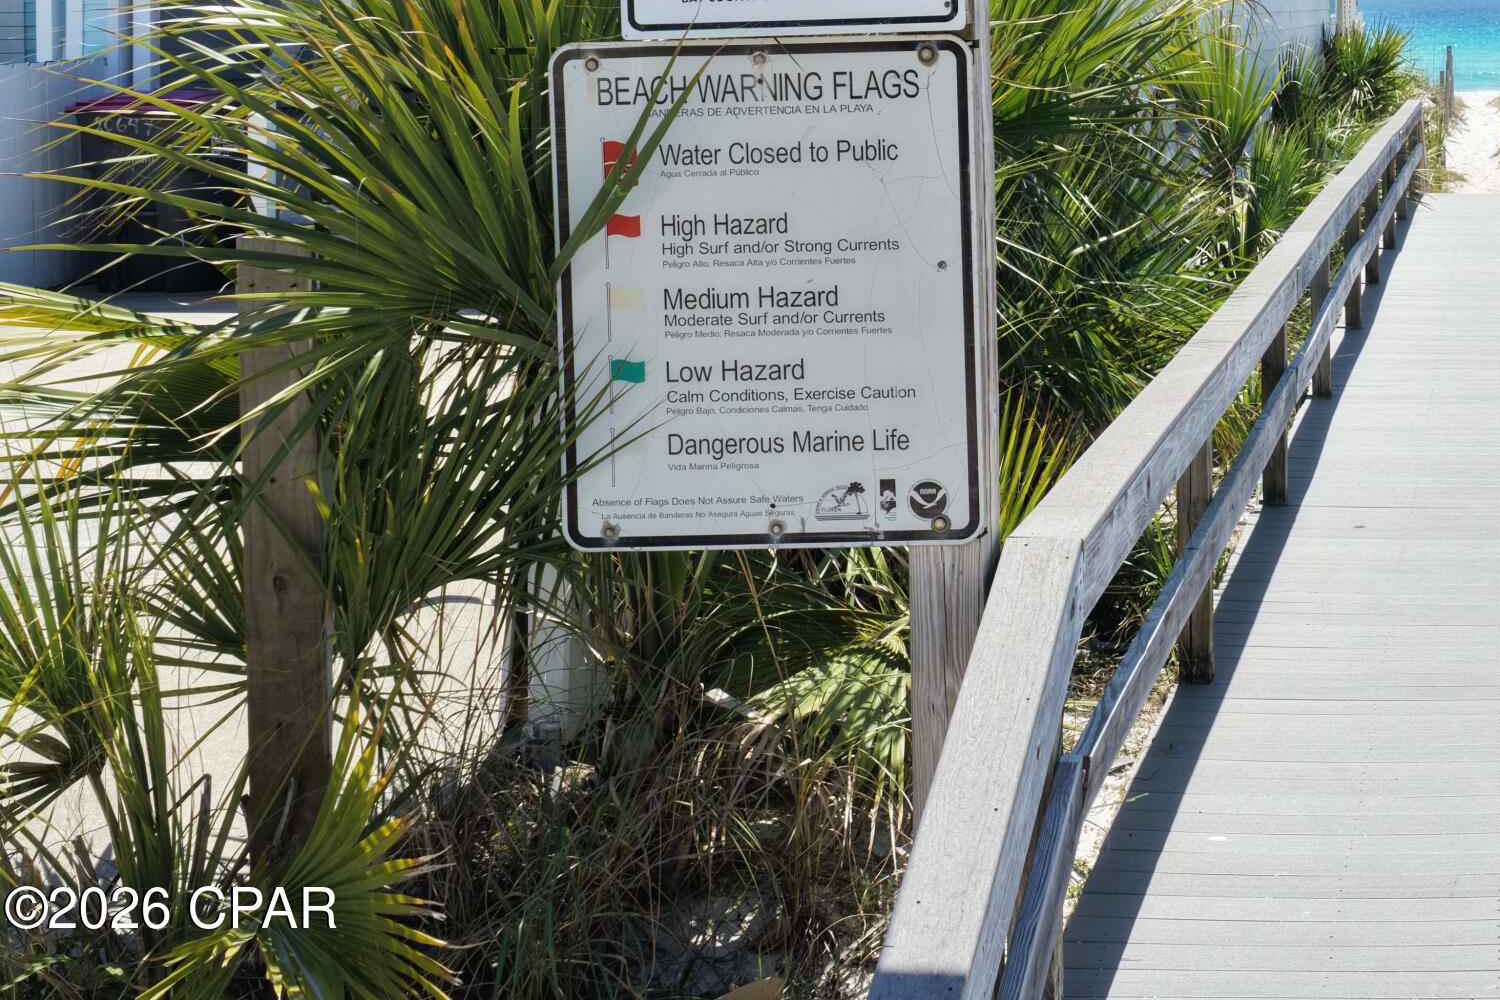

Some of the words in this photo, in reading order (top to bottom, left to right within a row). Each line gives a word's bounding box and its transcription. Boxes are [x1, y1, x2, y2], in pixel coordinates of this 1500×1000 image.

[597, 74, 688, 106] BEACH
[697, 72, 823, 104] WARNING
[833, 69, 920, 99] FLAGS
[707, 107, 722, 117] DE
[725, 105, 802, 117] ADVERTENCIA
[805, 105, 820, 114] EN
[823, 104, 837, 114] LA
[840, 103, 874, 113] PLAYA
[659, 142, 721, 166] Water
[729, 141, 801, 164] Closed
[809, 142, 828, 162] to
[837, 139, 898, 162] Public
[659, 168, 682, 180] Agua
[683, 169, 718, 178] Cerrada
[719, 168, 727, 176] al
[661, 214, 705, 242] High
[714, 212, 788, 235] Hazard
[662, 240, 694, 257] High
[699, 241, 729, 255] Surf
[733, 241, 780, 254] and/or
[784, 239, 832, 255] Strong
[837, 238, 900, 252] Currents
[664, 288, 749, 310] Medium
[758, 285, 838, 308] Hazard
[664, 314, 733, 327] Moderate
[738, 312, 768, 325] Surf
[772, 311, 819, 325] and/or
[823, 310, 885, 323] Currents
[666, 361, 712, 383] Low
[722, 358, 804, 381] Hazard
[667, 390, 704, 403] Calm
[709, 389, 788, 402] Conditions,
[794, 387, 856, 400] Exercise
[860, 386, 916, 399] Caution
[668, 433, 784, 459] Dangerous
[793, 430, 864, 453] Marine
[873, 428, 909, 451] Life
[667, 463, 687, 471] Vida
[720, 462, 759, 471] Peligrosa
[592, 498, 632, 507] Absence
[633, 497, 643, 506] of
[645, 497, 669, 508] Flags
[671, 497, 696, 506] Does
[698, 496, 713, 505] Not
[716, 496, 747, 505] Assure
[749, 494, 771, 505] Safe
[772, 494, 804, 504] Waters
